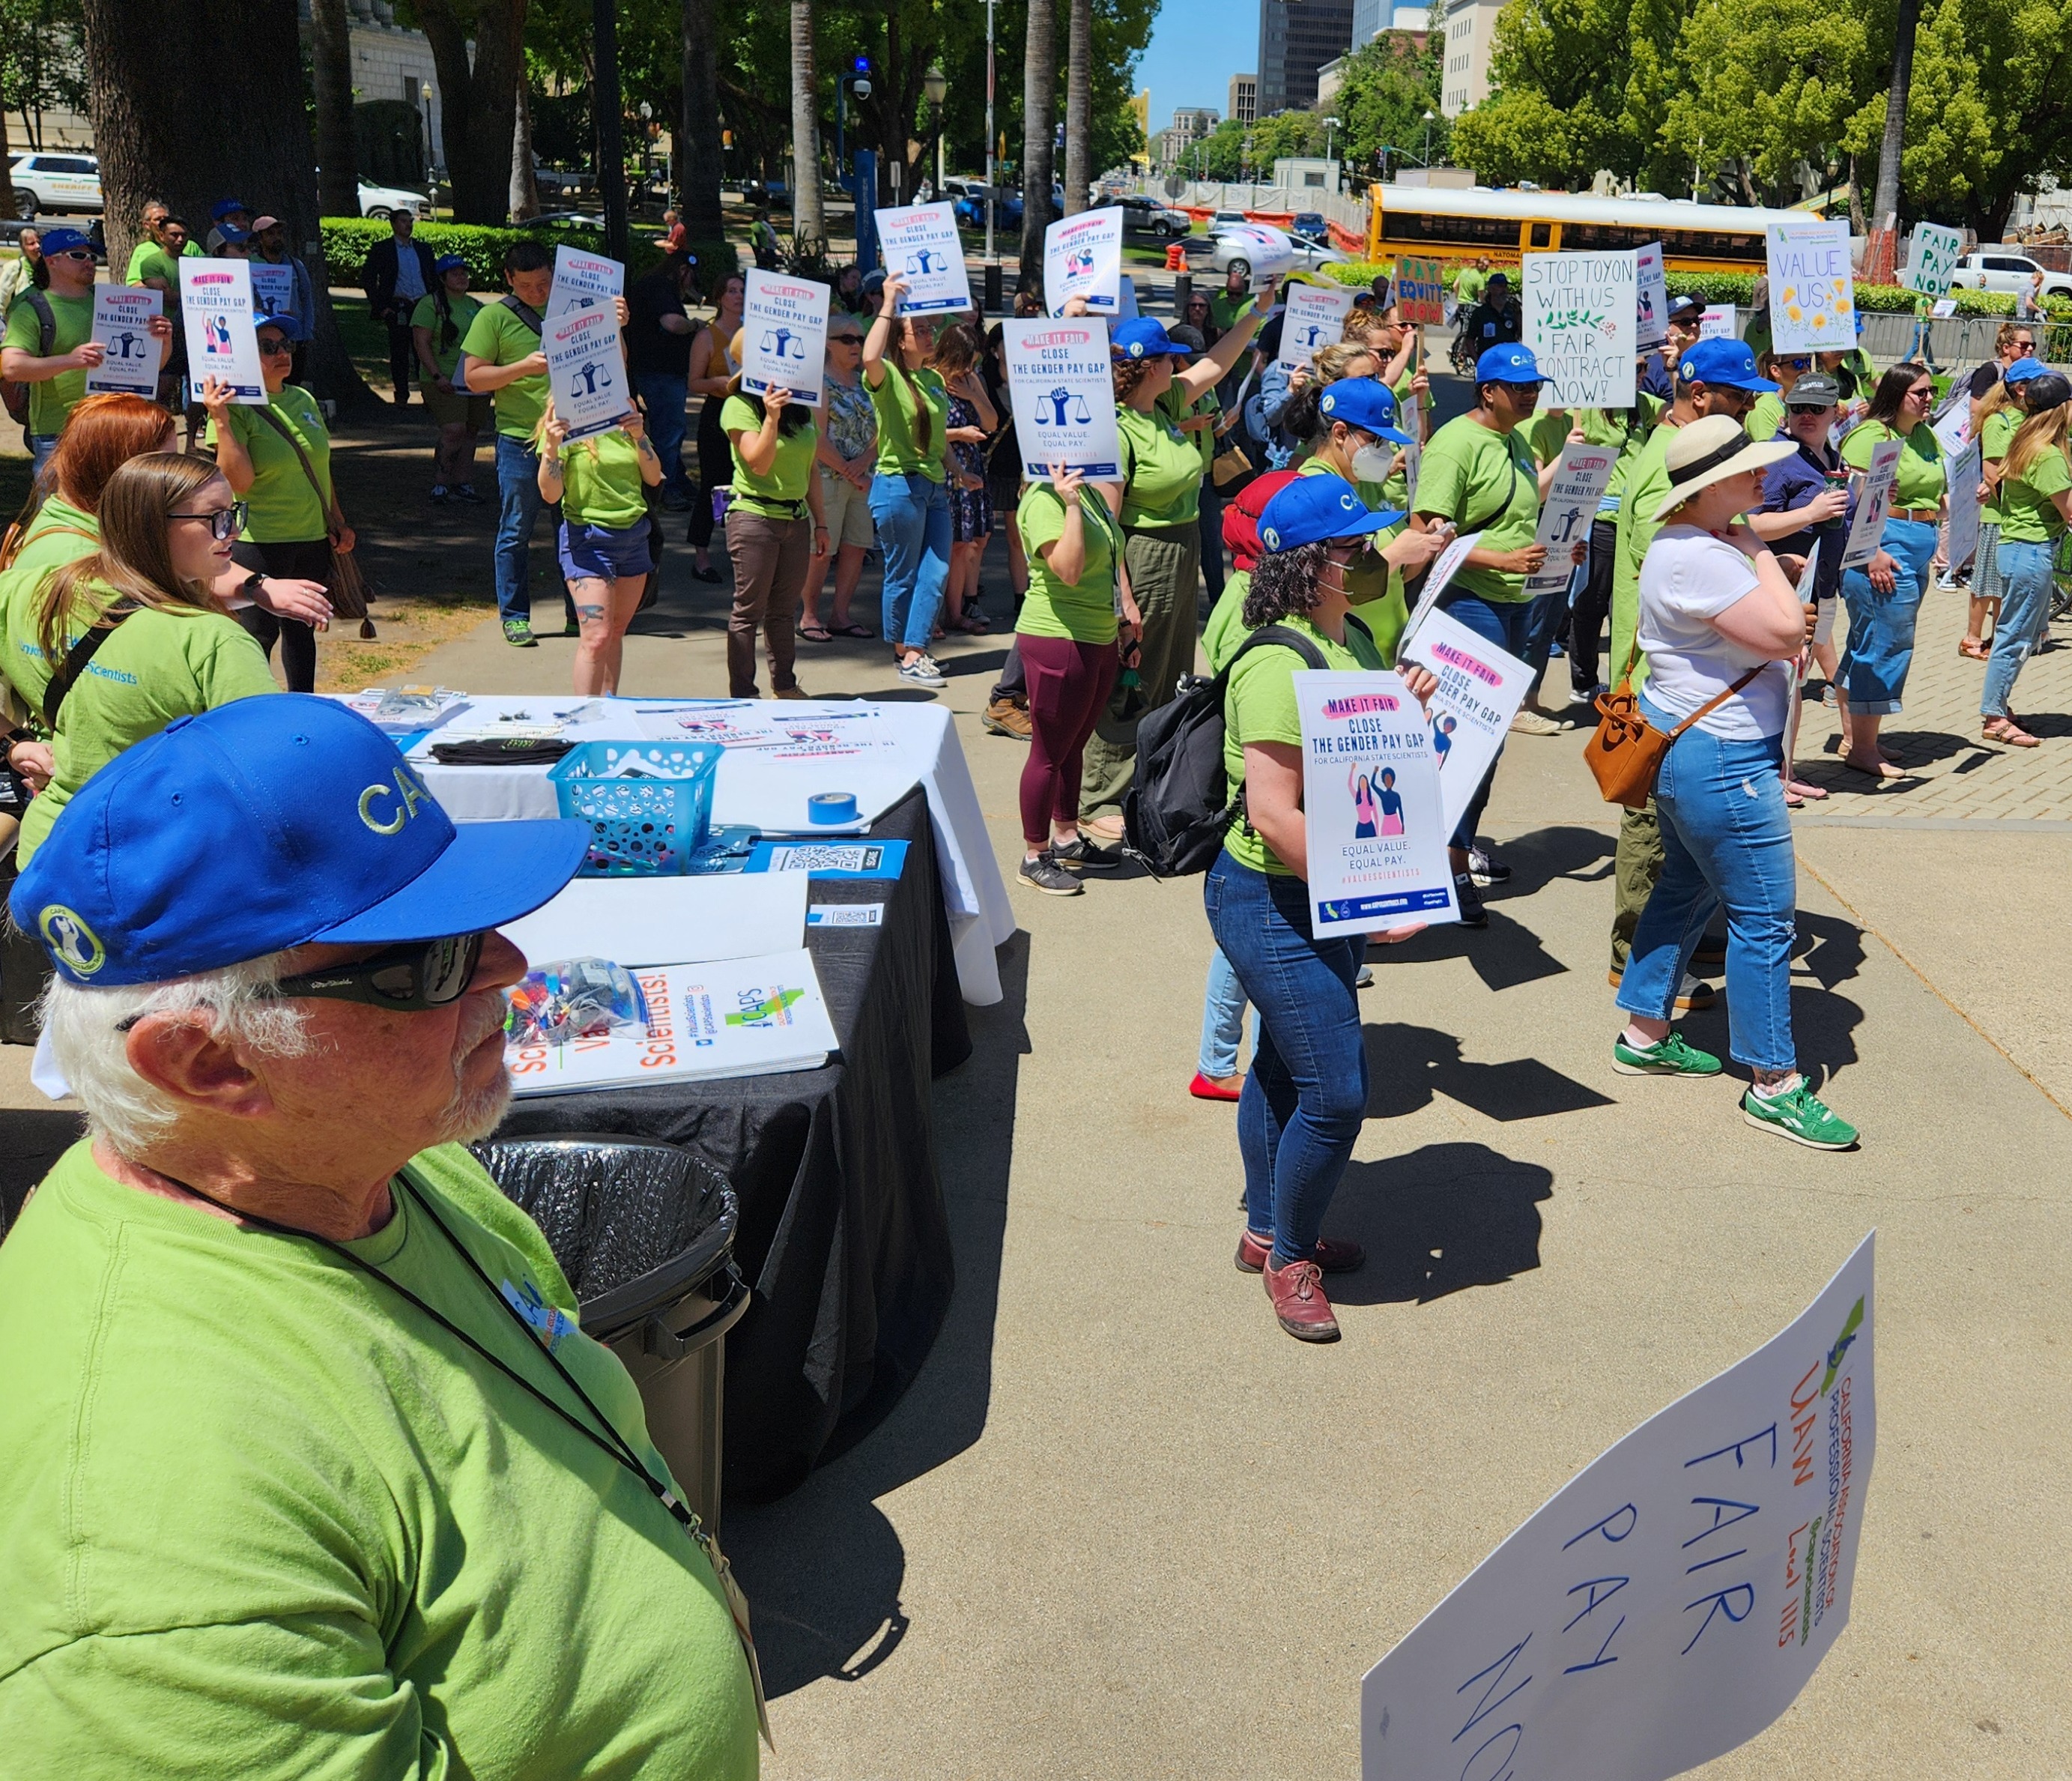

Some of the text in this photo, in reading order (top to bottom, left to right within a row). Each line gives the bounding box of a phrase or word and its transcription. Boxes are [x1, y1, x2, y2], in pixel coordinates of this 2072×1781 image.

[906, 225, 927, 233] CLOSE
[1070, 231, 1089, 241] CLOSE
[900, 235, 924, 244] GENDER
[1050, 246, 1060, 255] THE
[1062, 239, 1085, 250] GENDER
[1921, 229, 1958, 255] FAIR
[1402, 258, 1437, 282] PAY
[1529, 259, 1632, 284] STOP TOYON
[1777, 250, 1842, 278] VALUE
[1921, 250, 1954, 276] PAY
[217, 274, 231, 284] FAIR
[557, 275, 569, 284] THE
[572, 278, 595, 289] GENDER
[597, 284, 608, 293] PAY
[581, 270, 600, 281] CLOSE
[1914, 273, 1950, 296] NOW
[186, 296, 246, 306] THE GENDER PAY GAP
[202, 288, 220, 296] CLOSE
[1399, 280, 1443, 303] EQUITY
[1536, 288, 1615, 309] WITH US
[1797, 282, 1824, 308] US
[118, 305, 138, 314] CLOSE
[775, 297, 796, 309] CLOSE
[1309, 303, 1325, 312] CLOSE
[1403, 302, 1441, 323] NOW
[97, 312, 108, 321] THE
[110, 315, 133, 324] GENDER
[750, 302, 823, 326] THE GENDER PAY GAP
[1300, 309, 1319, 318] GENDER
[571, 330, 591, 345] CLOSE
[1027, 333, 1085, 345] MAKE IT FAIR
[1552, 333, 1596, 354] FAIR
[551, 333, 617, 364] THE GENDER PAY GAP
[1041, 348, 1069, 359] CLOSE
[760, 356, 779, 366] EQUAL
[763, 363, 782, 373] EQUAL
[1013, 363, 1105, 375] THE GENDER PAY GAP
[1552, 380, 1608, 403] NOW!
[574, 399, 593, 409] EQUAL
[578, 399, 611, 414] EQUAL PAY.
[1570, 458, 1605, 471] MAKE FAIR
[1575, 472, 1593, 483] CLOSE
[1553, 483, 1594, 496] THE GENDER PAY
[88, 660, 138, 685] Scientists
[1436, 641, 1497, 686] MAKE IT FAIR
[1441, 665, 1473, 692] CLOSE
[1327, 698, 1396, 713] MAKE IT FAIR
[1436, 677, 1502, 726] NDER PAY GAP
[1348, 718, 1382, 734] CLOSE
[1444, 700, 1496, 735] STATE SCIENTISTS
[1312, 733, 1425, 754] THE GENDER PAY GAP
[1314, 751, 1428, 765] FOR CALIFORNIA STATE SCIENTISTS
[357, 766, 431, 835] CA
[1342, 841, 1411, 856] EQUAL VALUE.
[1350, 856, 1407, 871] EQUAL PAY.
[1342, 868, 1420, 884] #VALUESCIENTISTS
[737, 988, 768, 1021] CAPS
[640, 973, 676, 1068] Scientists!
[683, 994, 699, 1038] #ValueScientists
[1839, 1376, 1852, 1487] CALIFORNIA
[1778, 1360, 1820, 1648] UAW Local 1115
[1814, 1388, 1841, 1627] PROFESSIONAL SCIENTISTS
[1680, 1421, 1779, 1656] FAIR
[1829, 1484, 1850, 1590] ASSOCIATION
[1561, 1502, 1638, 1675] PAY
[1450, 1631, 1533, 1781] NO
